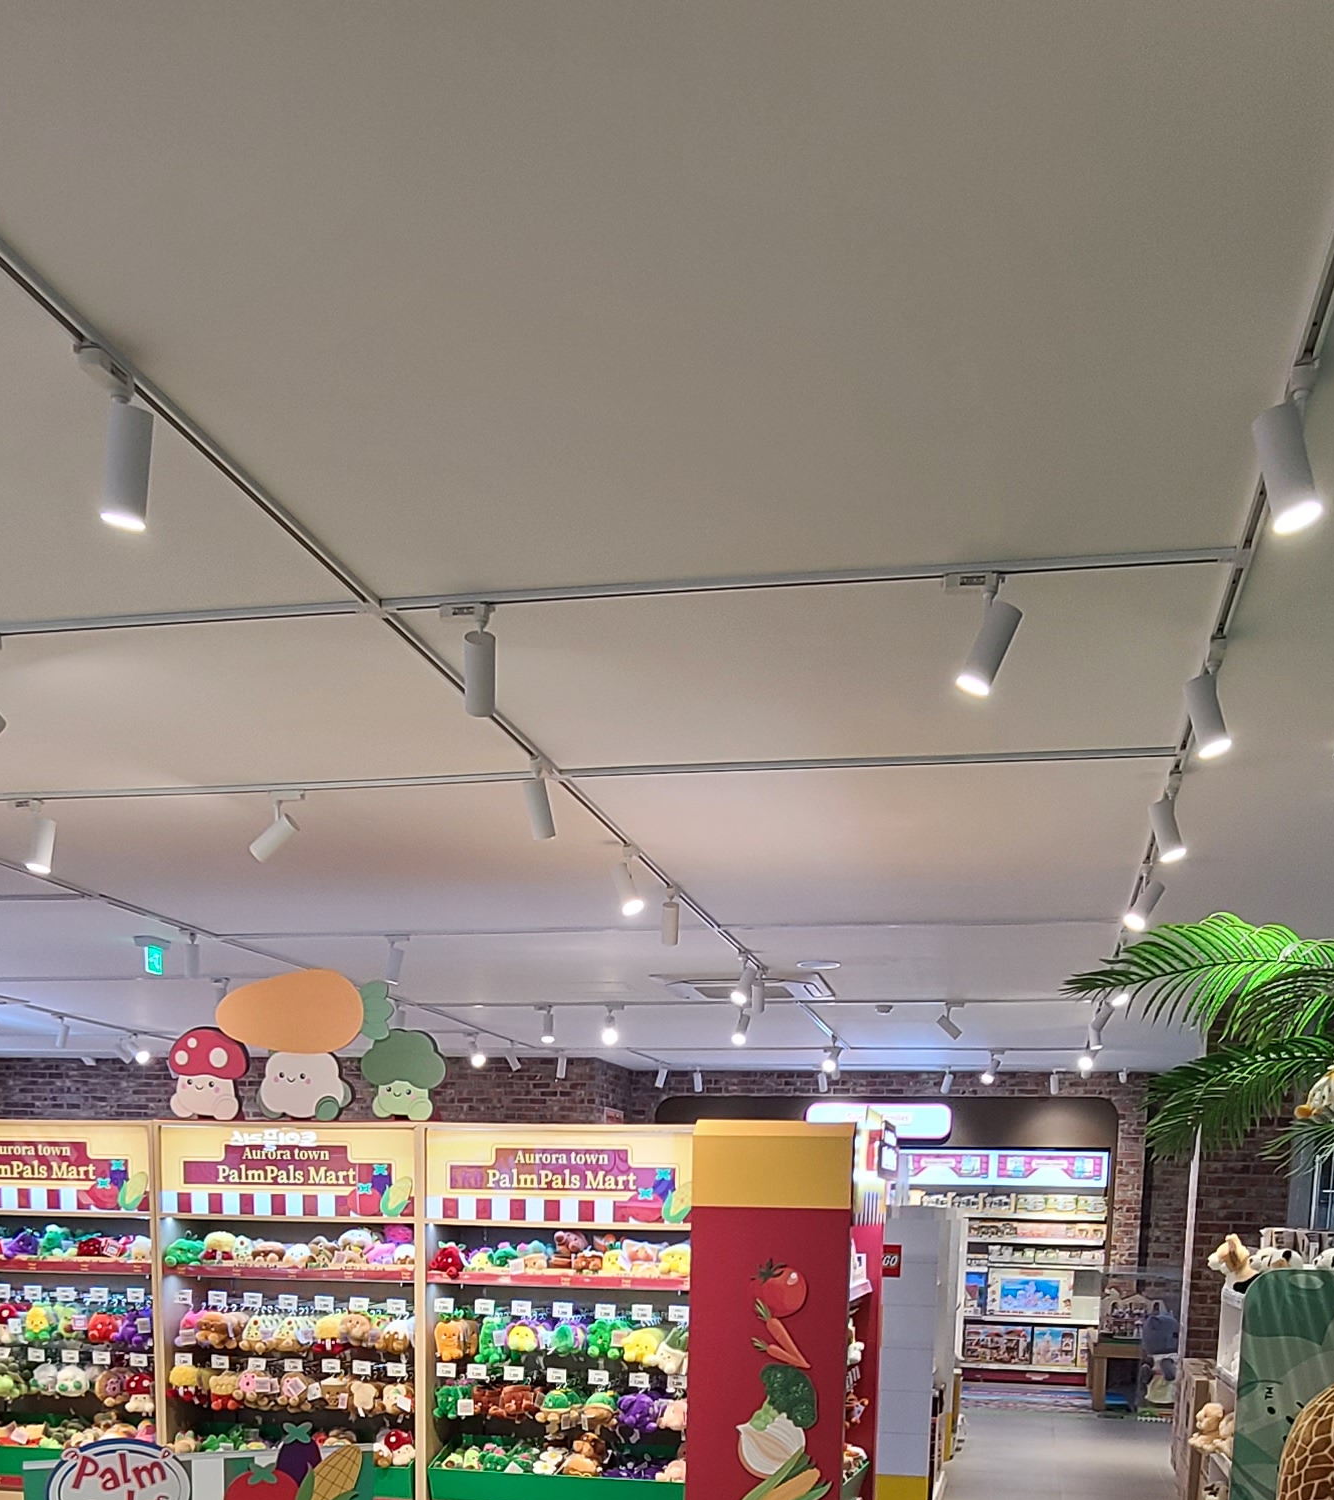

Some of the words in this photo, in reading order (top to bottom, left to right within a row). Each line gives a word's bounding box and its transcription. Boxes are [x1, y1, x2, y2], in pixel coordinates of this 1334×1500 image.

[37, 1144, 71, 1156] town
[242, 1147, 292, 1160] Aurora
[294, 1148, 330, 1161] town
[514, 1150, 567, 1165] Aurora
[570, 1151, 609, 1165] town
[50, 1161, 96, 1180] Mart
[216, 1164, 305, 1184] PalmPals
[307, 1166, 356, 1185] Mart
[486, 1168, 581, 1190] PalmPals
[584, 1170, 637, 1190] Mart
[73, 1455, 167, 1490] Palm
